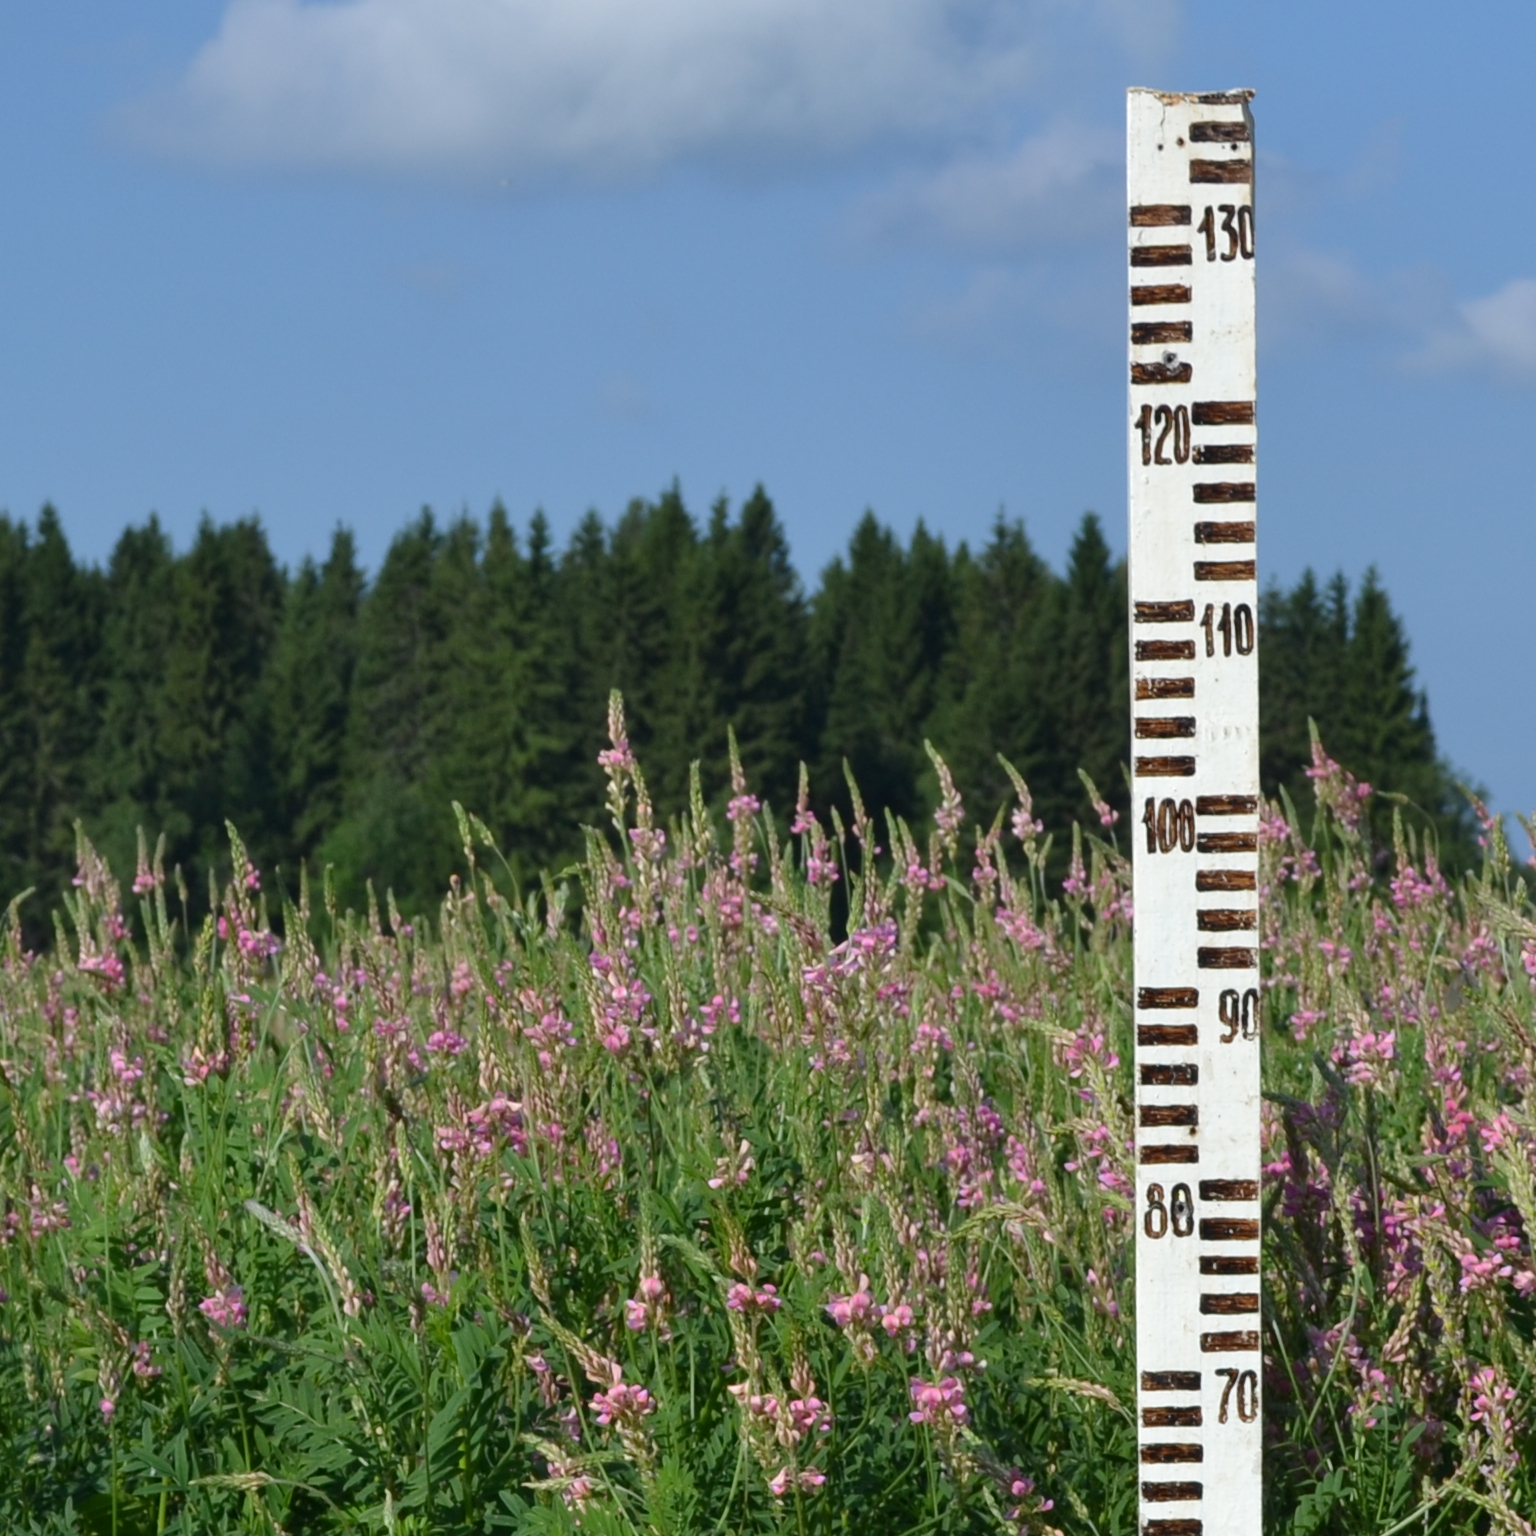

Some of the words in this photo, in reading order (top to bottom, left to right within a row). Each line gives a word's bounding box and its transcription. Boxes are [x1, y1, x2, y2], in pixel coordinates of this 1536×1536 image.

[1198, 204, 1254, 261] 130
[1136, 404, 1191, 465] 120
[1200, 602, 1253, 657] 110
[1143, 797, 1195, 854] 100
[1219, 988, 1258, 1043] 90
[1145, 1182, 1195, 1239] 80
[1215, 1369, 1259, 1424] 70
